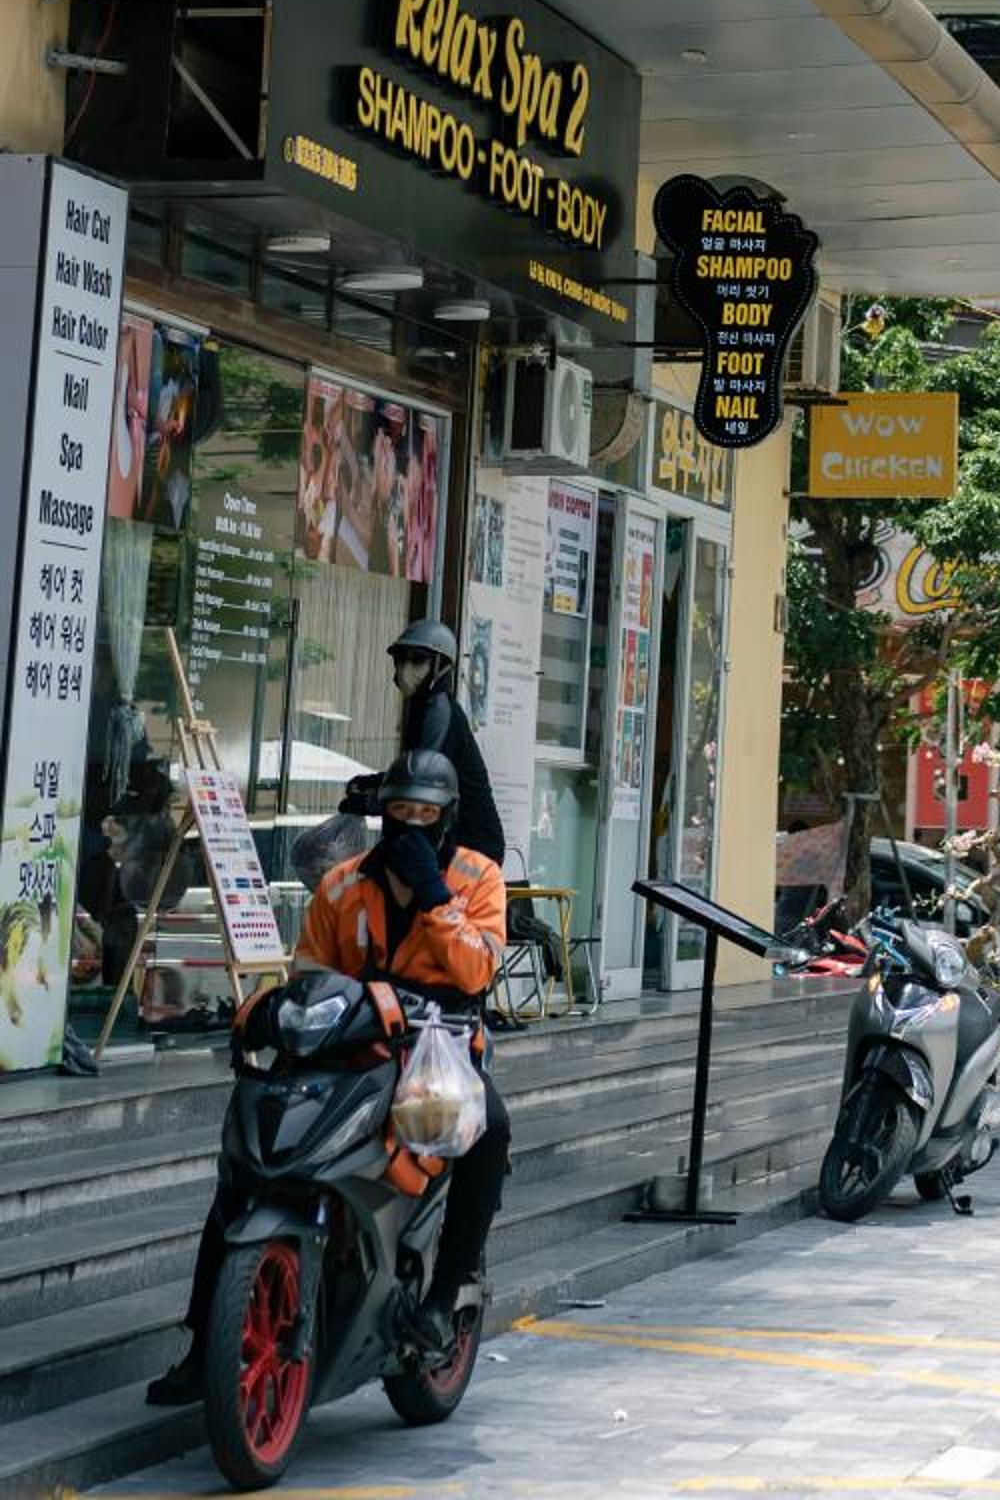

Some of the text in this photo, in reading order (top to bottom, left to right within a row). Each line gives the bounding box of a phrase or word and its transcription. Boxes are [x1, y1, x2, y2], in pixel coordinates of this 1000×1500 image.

[500, 17, 564, 148] Spa
[564, 63, 590, 157] 2
[357, 67, 475, 180] SHAMPOO
[489, 139, 545, 217] FOOT
[556, 178, 607, 251] BODY
[65, 199, 110, 245] Hair Cut
[702, 209, 767, 234] FACIAL
[729, 237, 767, 253] 마사지
[56, 251, 112, 299] Hair Wash
[696, 255, 793, 281] SHAMPOO
[52, 306, 109, 352] Hair Color
[722, 302, 773, 327] BODY
[716, 351, 765, 376] FOOT
[63, 372, 89, 412] Nail
[729, 379, 766, 395] 마사지
[715, 395, 760, 420] NAIL
[838, 410, 928, 438] WOW
[724, 421, 750, 436] 네일
[58, 433, 83, 472] Spa
[39, 488, 94, 538] Massage
[40, 563, 67, 601] 헤어
[29, 611, 57, 649] 헤어
[25, 660, 83, 702] 헤어 염색
[33, 760, 60, 799] 네일
[29, 812, 56, 845] 스파
